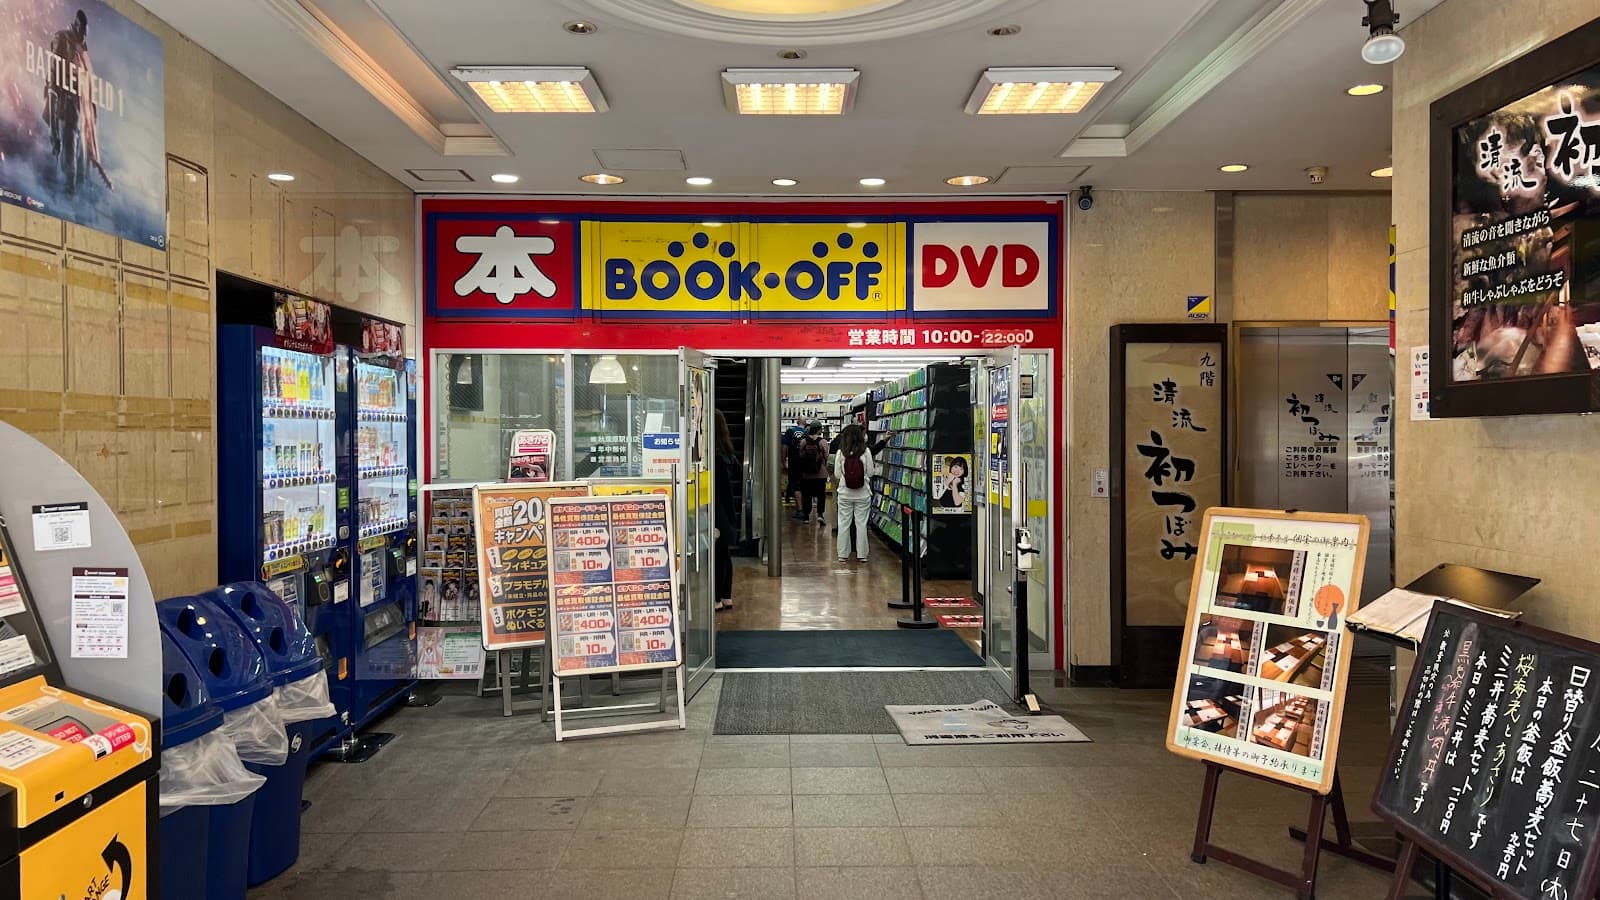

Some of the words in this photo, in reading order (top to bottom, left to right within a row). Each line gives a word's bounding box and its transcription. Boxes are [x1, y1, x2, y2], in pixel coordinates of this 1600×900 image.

[26, 40, 114, 112] BATTLEFIELD
[118, 88, 124, 117] 1
[1462, 211, 1550, 248] 清流の音を聞きながら
[454, 225, 557, 304] 本
[922, 244, 1040, 289] DVD
[1462, 251, 1516, 277] 新鮮な魚介類
[1462, 270, 1564, 306] 和牛しゃぶしゃぶをどうぞ
[848, 329, 915, 345] 営業時間
[1200, 352, 1216, 388] 九階
[1152, 377, 1207, 432] 清流
[576, 535, 606, 546] 400円
[635, 533, 664, 543] 400円
[582, 559, 603, 570] 10円
[640, 556, 661, 567] 10円
[580, 619, 611, 630] 400円
[640, 615, 669, 625] 400円
[586, 643, 608, 654] 10円
[646, 639, 667, 650] 10円
[111, 731, 132, 747] LITTER
[1511, 676, 1554, 786] 本日の釜飯は
